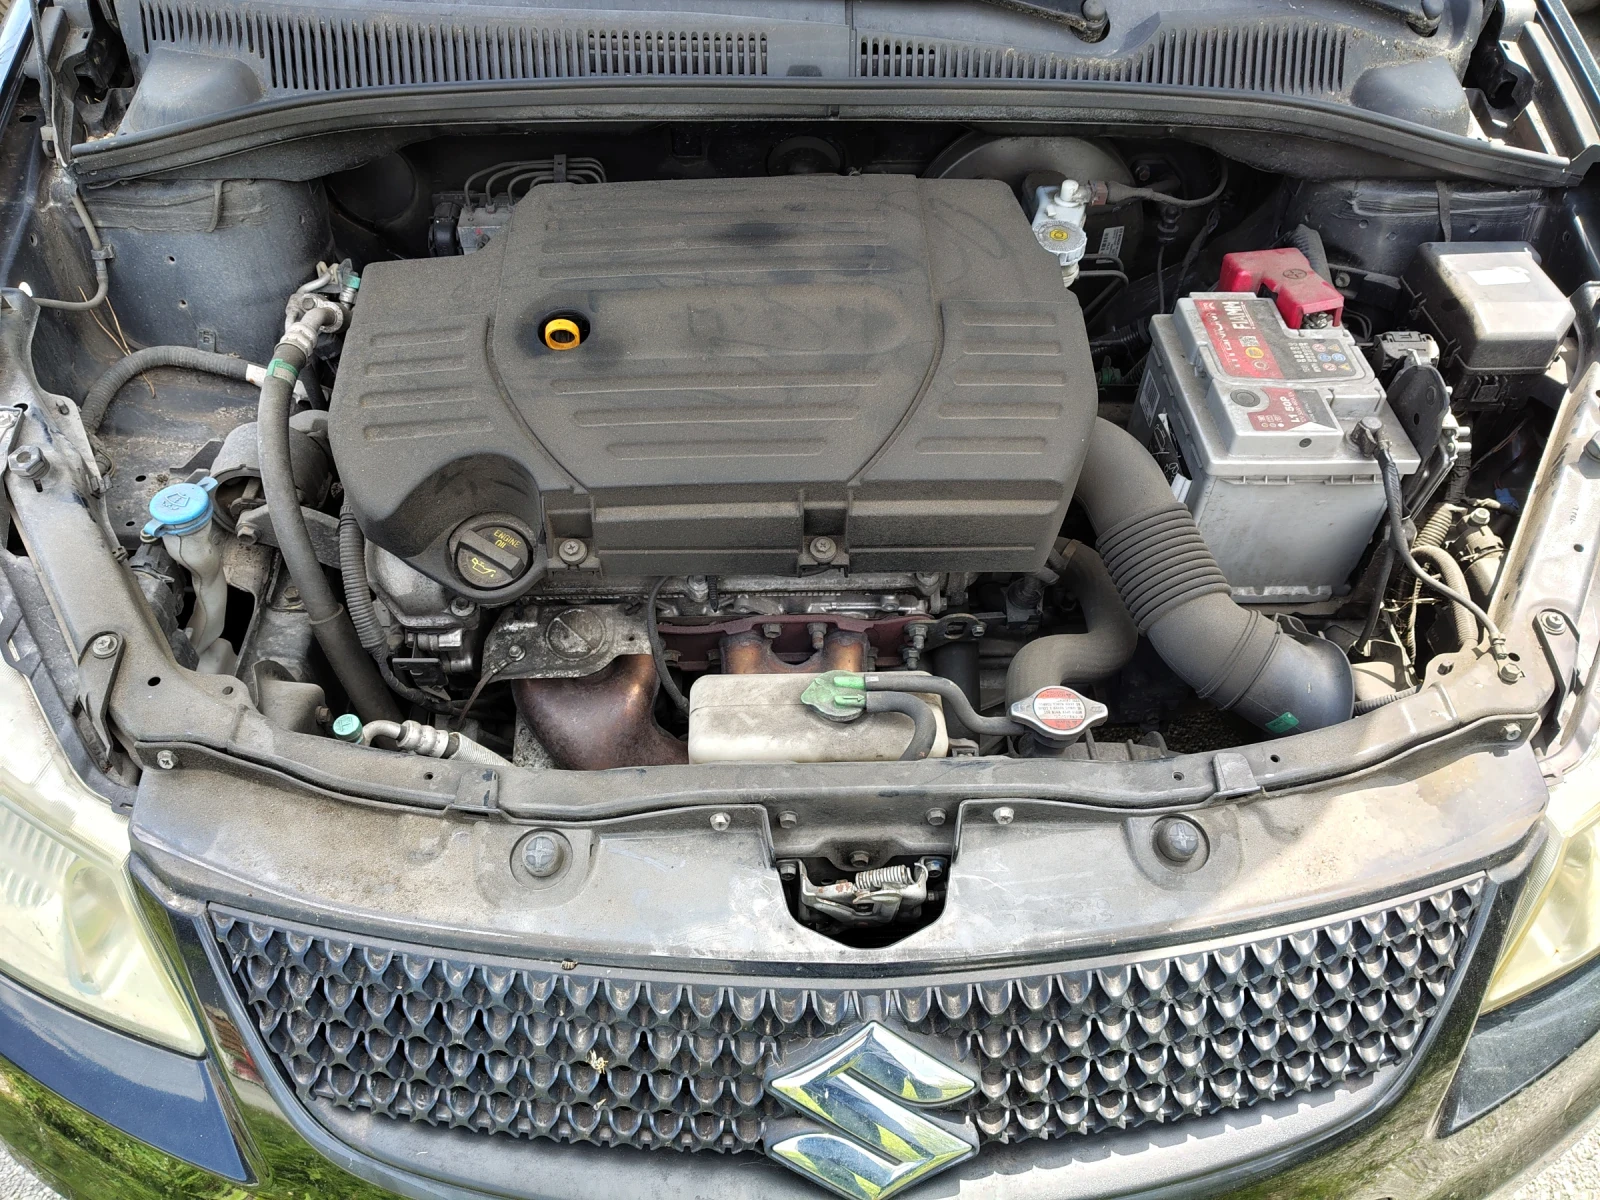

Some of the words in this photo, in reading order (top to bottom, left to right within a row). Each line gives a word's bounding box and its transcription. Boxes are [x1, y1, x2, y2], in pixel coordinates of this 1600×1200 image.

[1222, 301, 1251, 329] FIAMM
[1280, 396, 1295, 412] 50P
[1288, 413, 1300, 423] L1
[493, 529, 521, 549] ENGINE
